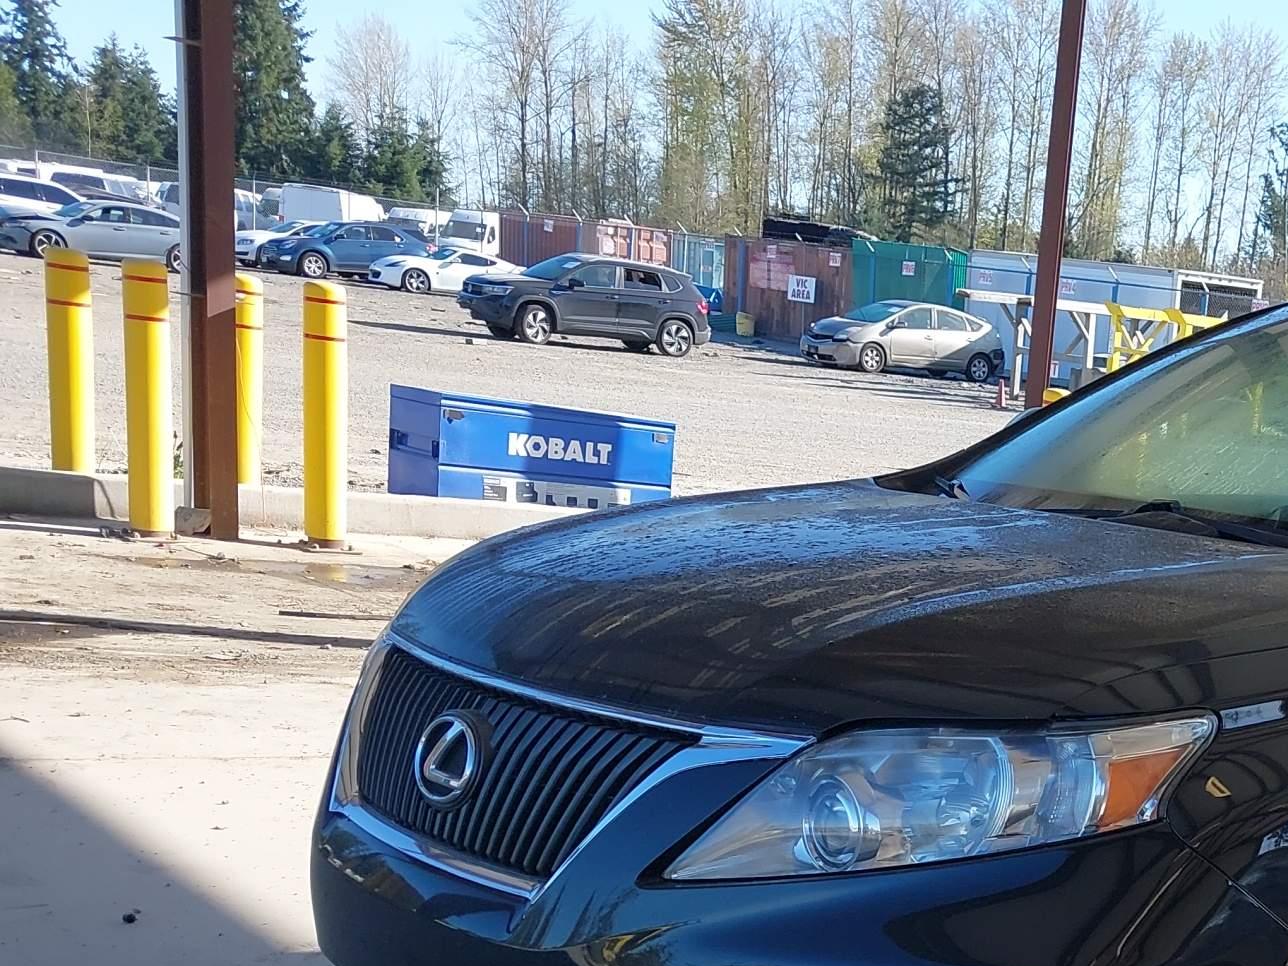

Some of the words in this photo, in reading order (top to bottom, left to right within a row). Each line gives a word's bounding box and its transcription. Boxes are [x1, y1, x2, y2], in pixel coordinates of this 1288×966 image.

[796, 278, 809, 290] VIC
[791, 289, 811, 301] AREA
[507, 432, 612, 465] KOBALT
